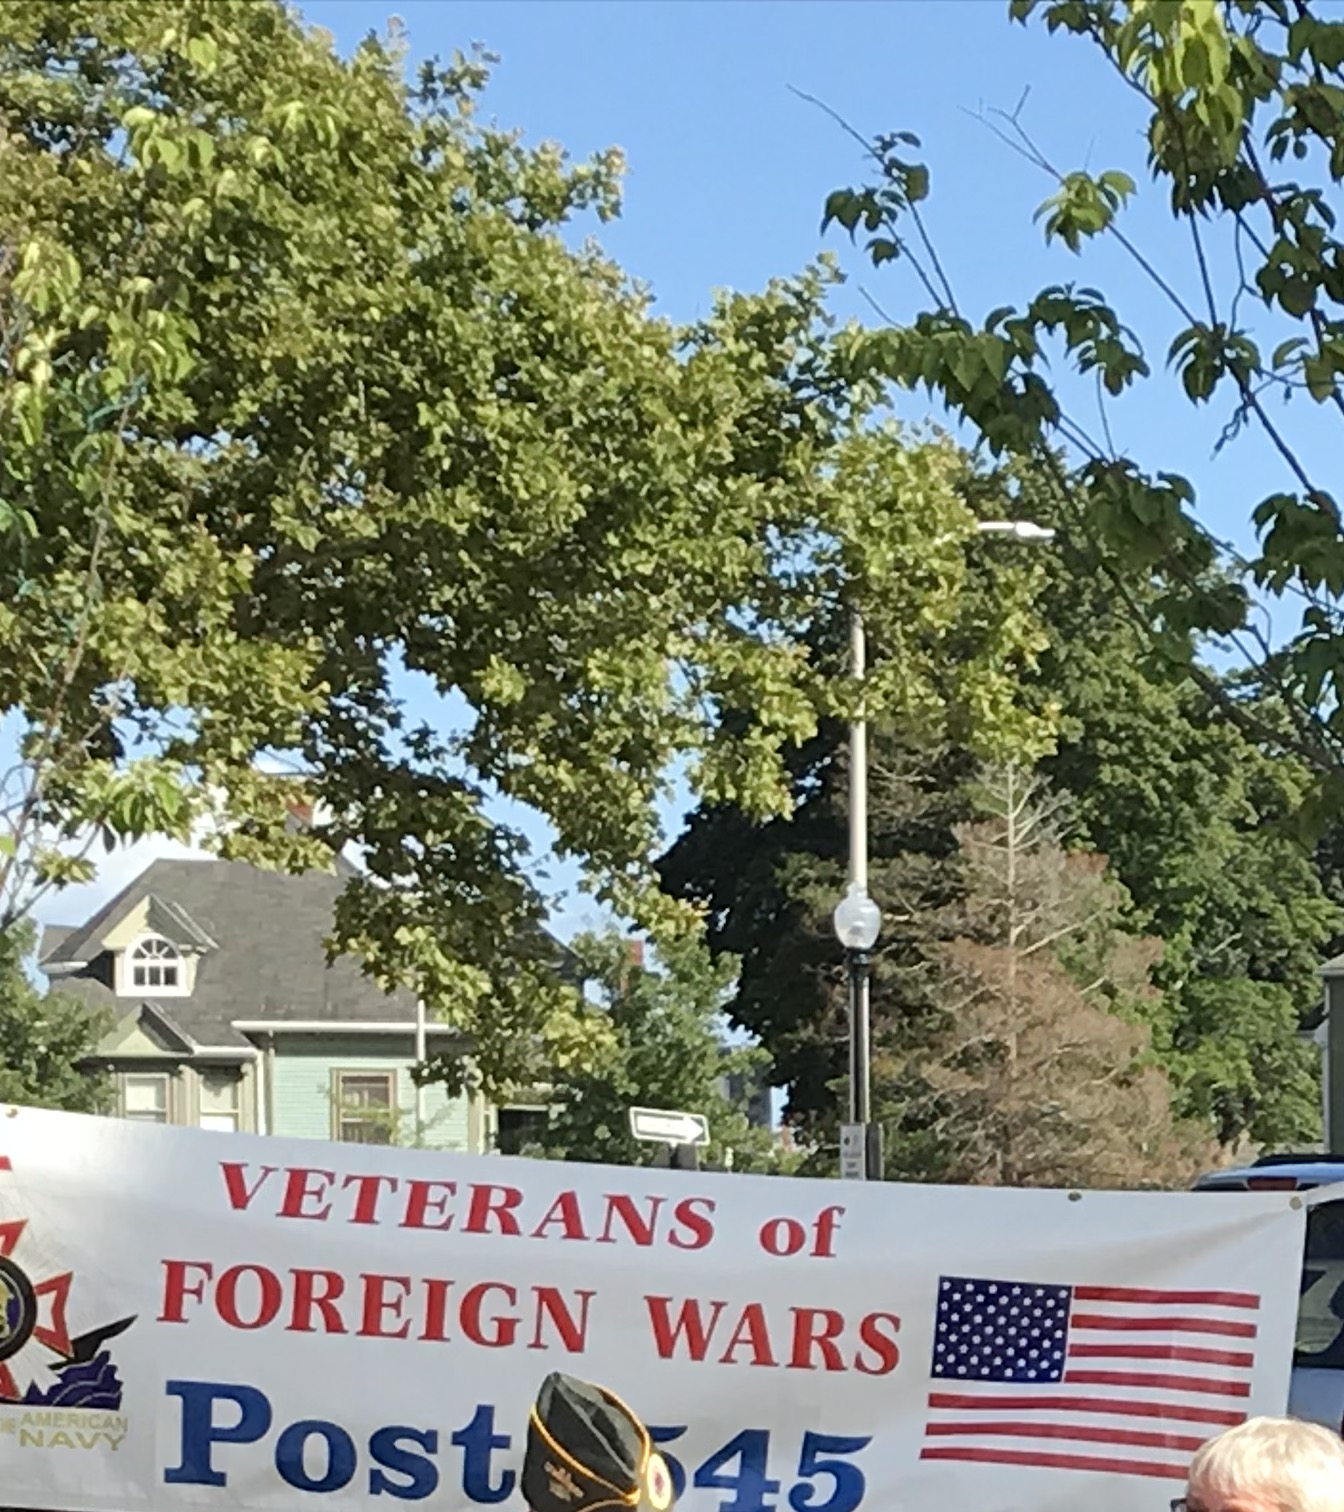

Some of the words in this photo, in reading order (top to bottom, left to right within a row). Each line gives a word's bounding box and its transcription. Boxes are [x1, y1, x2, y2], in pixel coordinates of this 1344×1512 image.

[219, 1161, 717, 1250] VETERANS
[758, 1205, 846, 1259] of
[156, 1259, 597, 1354] FOREIGN
[643, 1295, 903, 1377] WARS
[19, 1428, 127, 1451] NAVY
[20, 1411, 129, 1434] AMERICAN
[163, 1379, 517, 1504] Post
